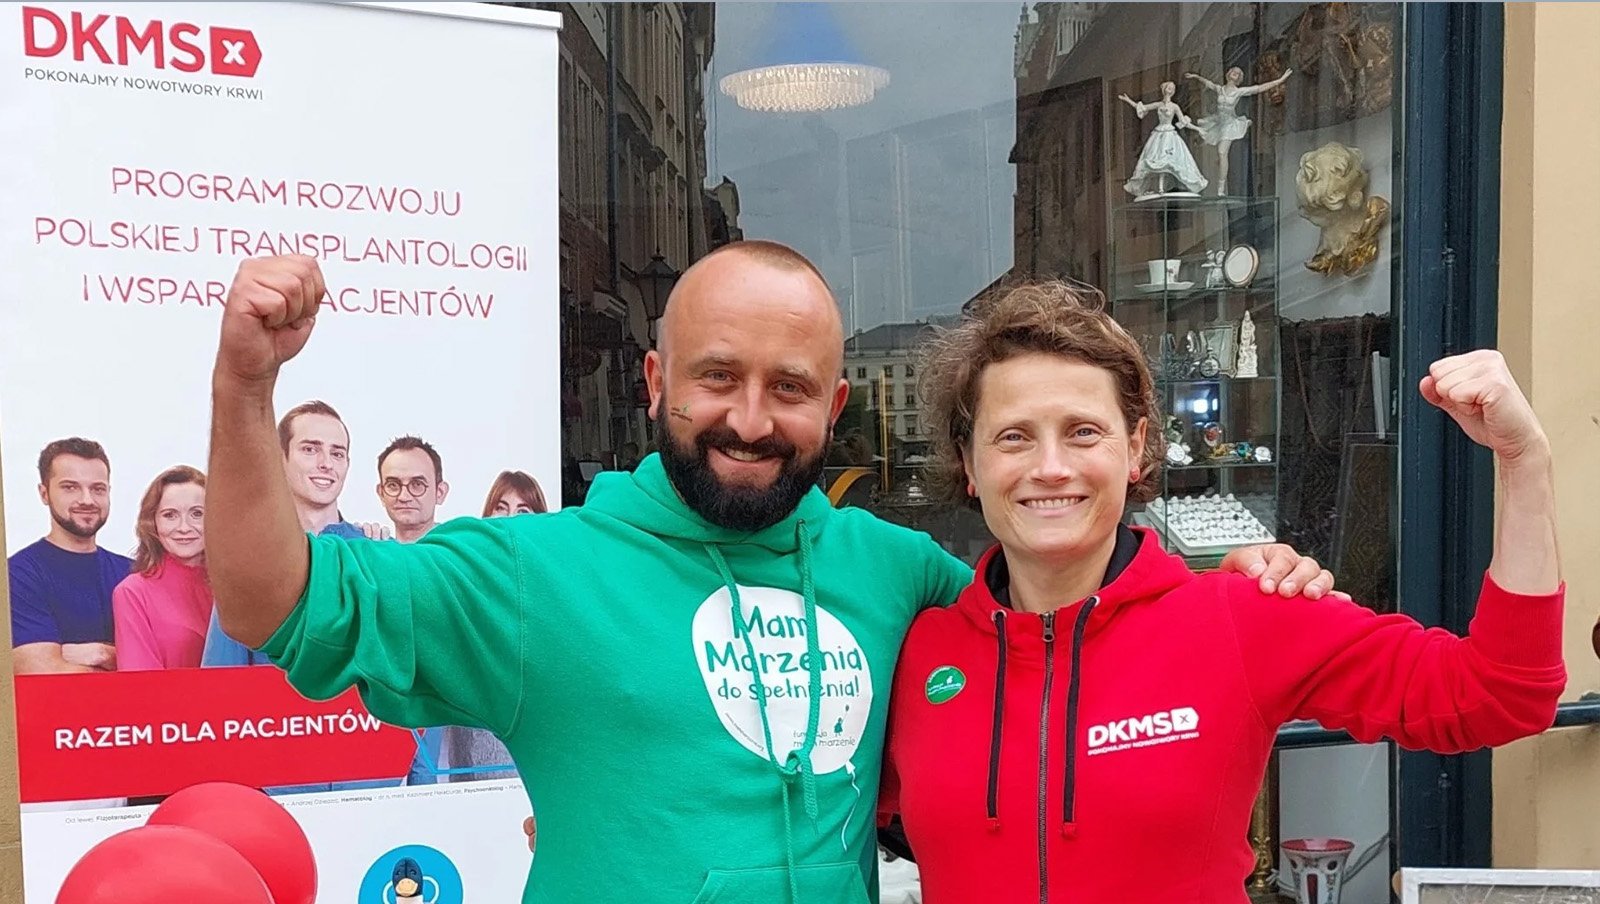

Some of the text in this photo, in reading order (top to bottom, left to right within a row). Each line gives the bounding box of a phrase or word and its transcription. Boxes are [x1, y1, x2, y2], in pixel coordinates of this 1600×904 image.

[22, 6, 205, 73] DKMS
[25, 67, 264, 101] POKONAJMY NOWOTWORY KRWI
[111, 167, 461, 216] PROGRAM ROZWOJU
[35, 217, 528, 272] POLSKIEJ TRANSPLANTOLOGII
[83, 274, 494, 319] I WSPAR ACJENTÓW
[731, 605, 808, 639] Mam
[704, 640, 863, 674] Marzenia
[717, 677, 742, 700] do
[54, 707, 382, 750] RAZEM DLA PACJENTÓW
[1087, 711, 1174, 748] DKMS
[96, 812, 142, 822] Fizjoterapeuta
